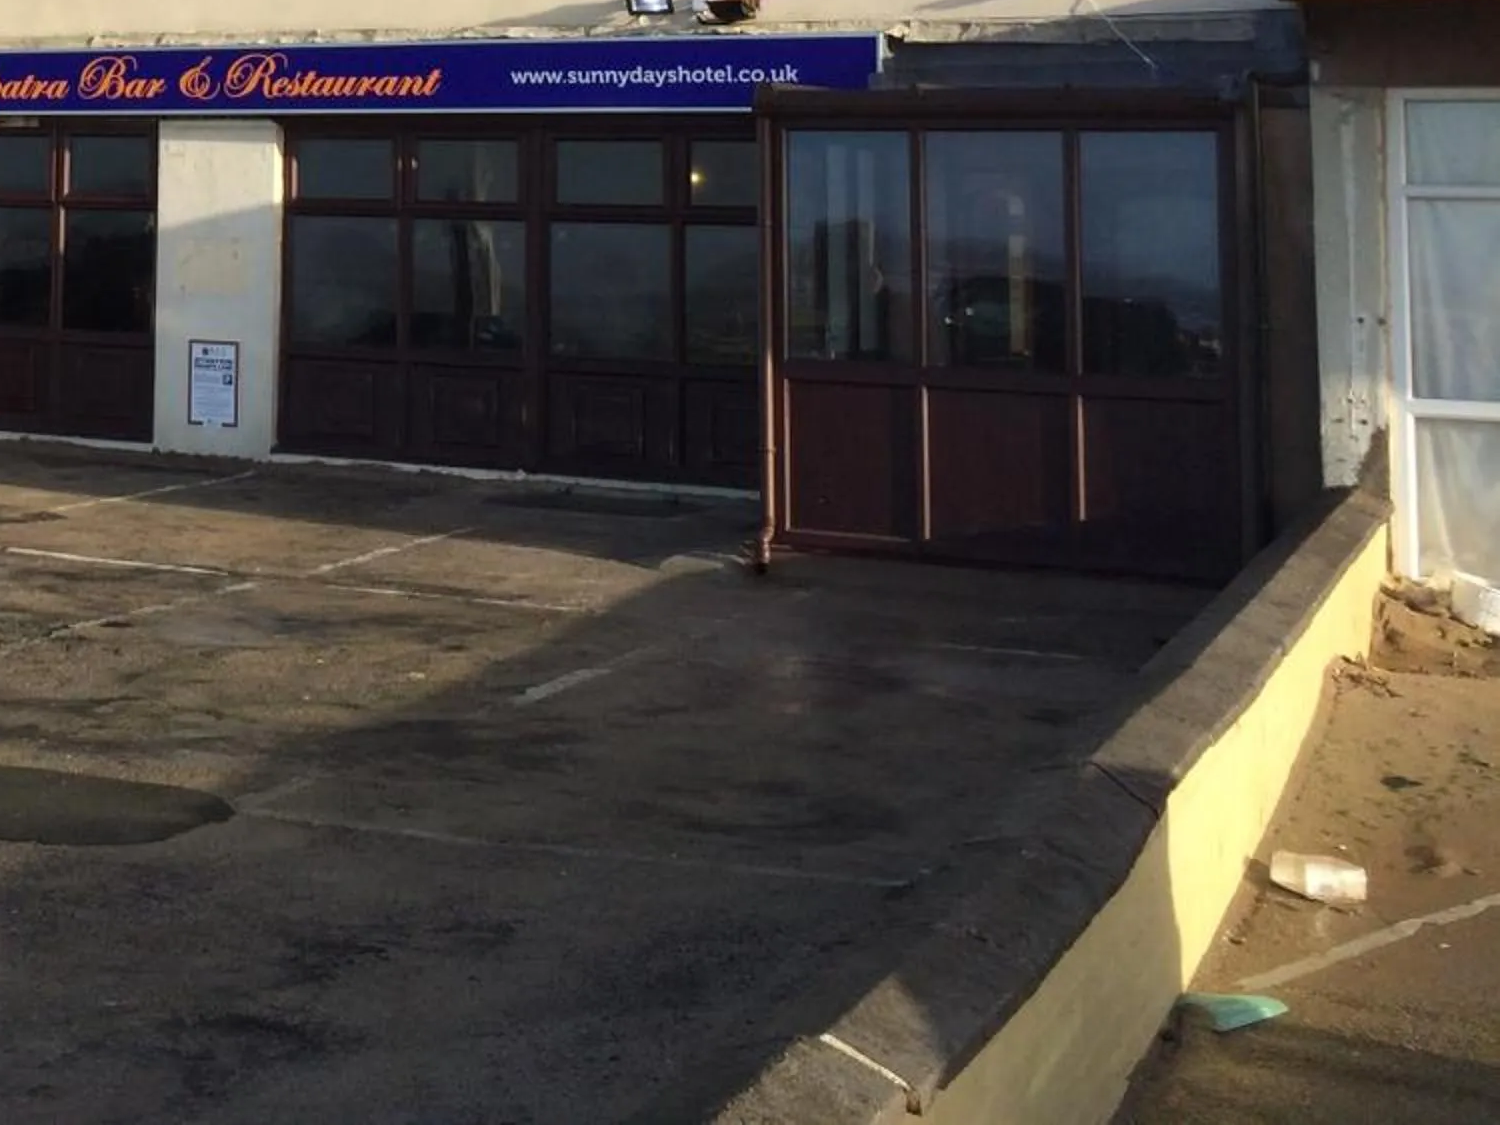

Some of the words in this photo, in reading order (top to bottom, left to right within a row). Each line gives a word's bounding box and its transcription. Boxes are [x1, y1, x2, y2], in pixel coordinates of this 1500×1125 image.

[76, 55, 167, 100] Bar
[178, 55, 219, 100] &
[223, 52, 443, 98] Restaurant
[510, 64, 799, 88] www.sunnydayshotel.co.uk
